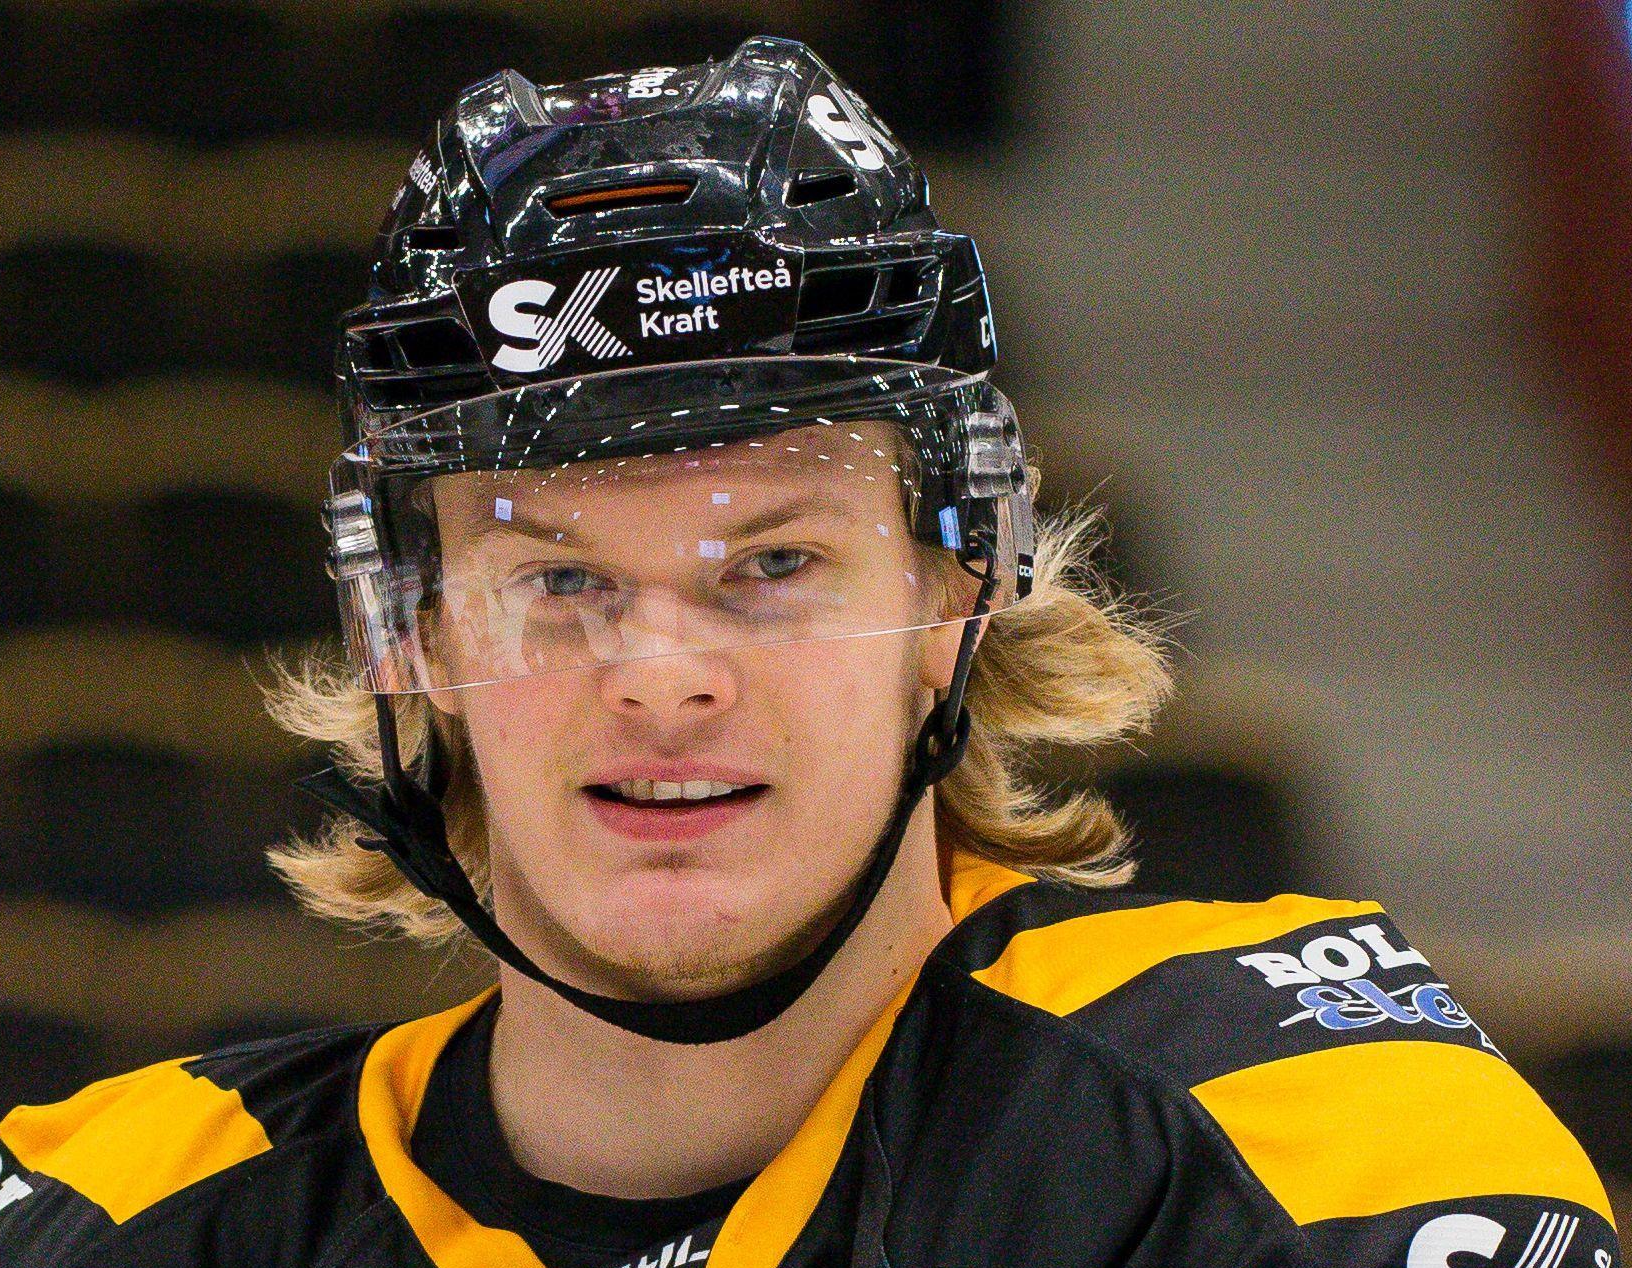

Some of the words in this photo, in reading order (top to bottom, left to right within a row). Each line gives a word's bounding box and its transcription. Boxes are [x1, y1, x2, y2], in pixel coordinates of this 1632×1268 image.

[636, 258, 792, 304] Skellefteå
[488, 266, 634, 372] SK
[639, 305, 720, 338] Kraft
